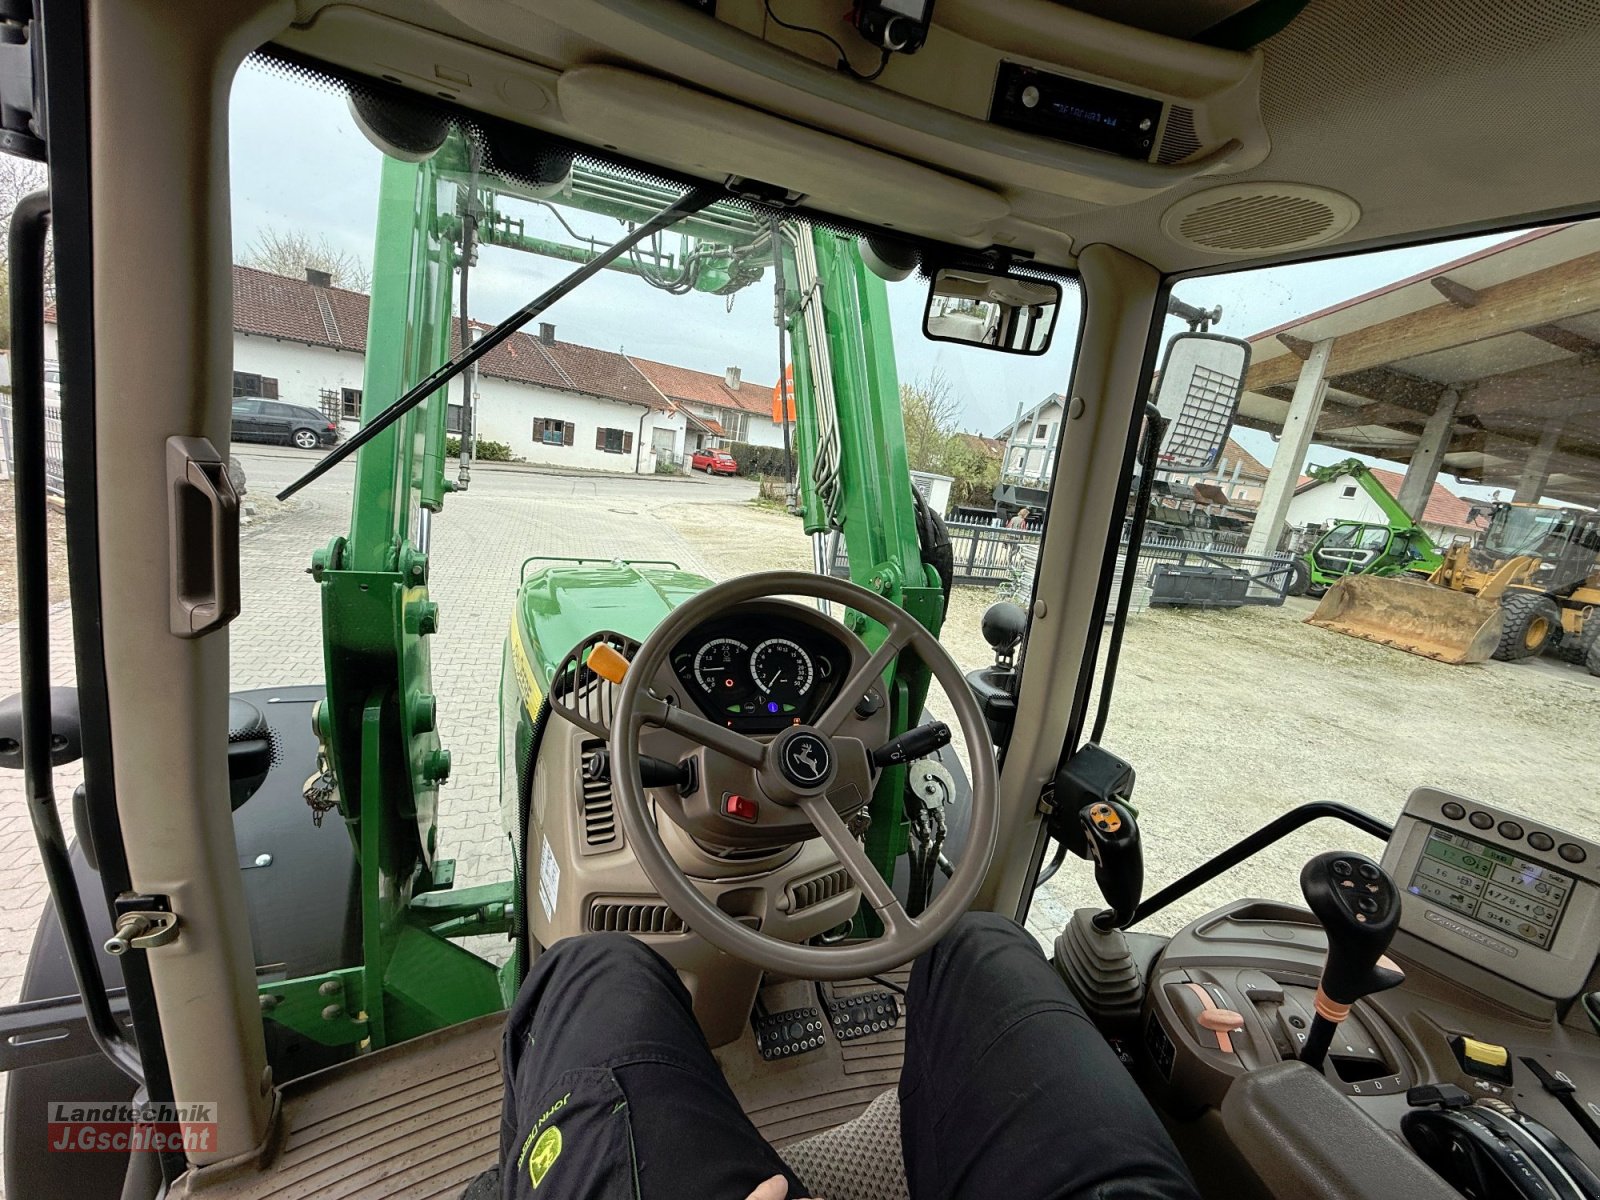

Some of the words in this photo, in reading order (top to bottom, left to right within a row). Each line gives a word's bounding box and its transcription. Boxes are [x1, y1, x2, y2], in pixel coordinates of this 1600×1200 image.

[1436, 867, 1448, 878] 16
[1421, 883, 1441, 896] 0.0
[1487, 889, 1531, 912] 4778.4
[1487, 911, 1512, 927] 9:46
[1353, 1084, 1361, 1093] B
[1375, 1081, 1383, 1090] D
[538, 1092, 571, 1126] JOHN
